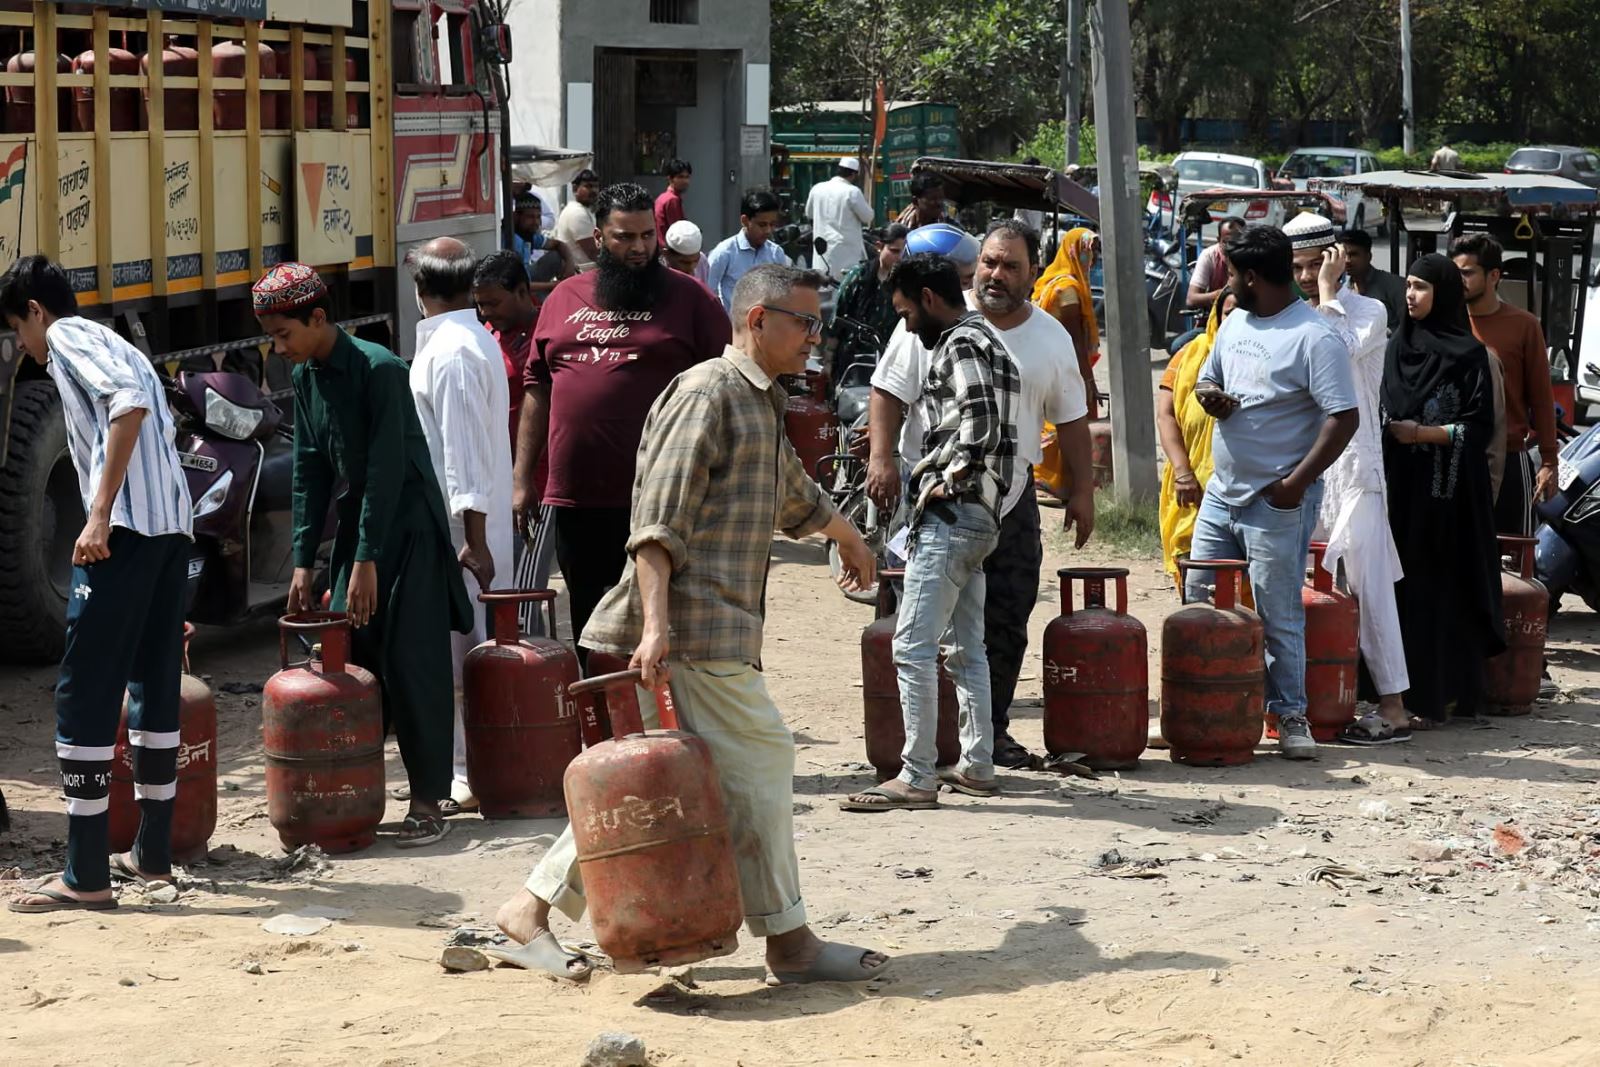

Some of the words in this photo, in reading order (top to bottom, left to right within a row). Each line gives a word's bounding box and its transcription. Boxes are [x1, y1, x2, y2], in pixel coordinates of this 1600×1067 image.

[565, 306, 653, 324] American
[576, 323, 630, 344] Eagle
[608, 351, 621, 362] 77
[585, 705, 598, 727] 15.4
